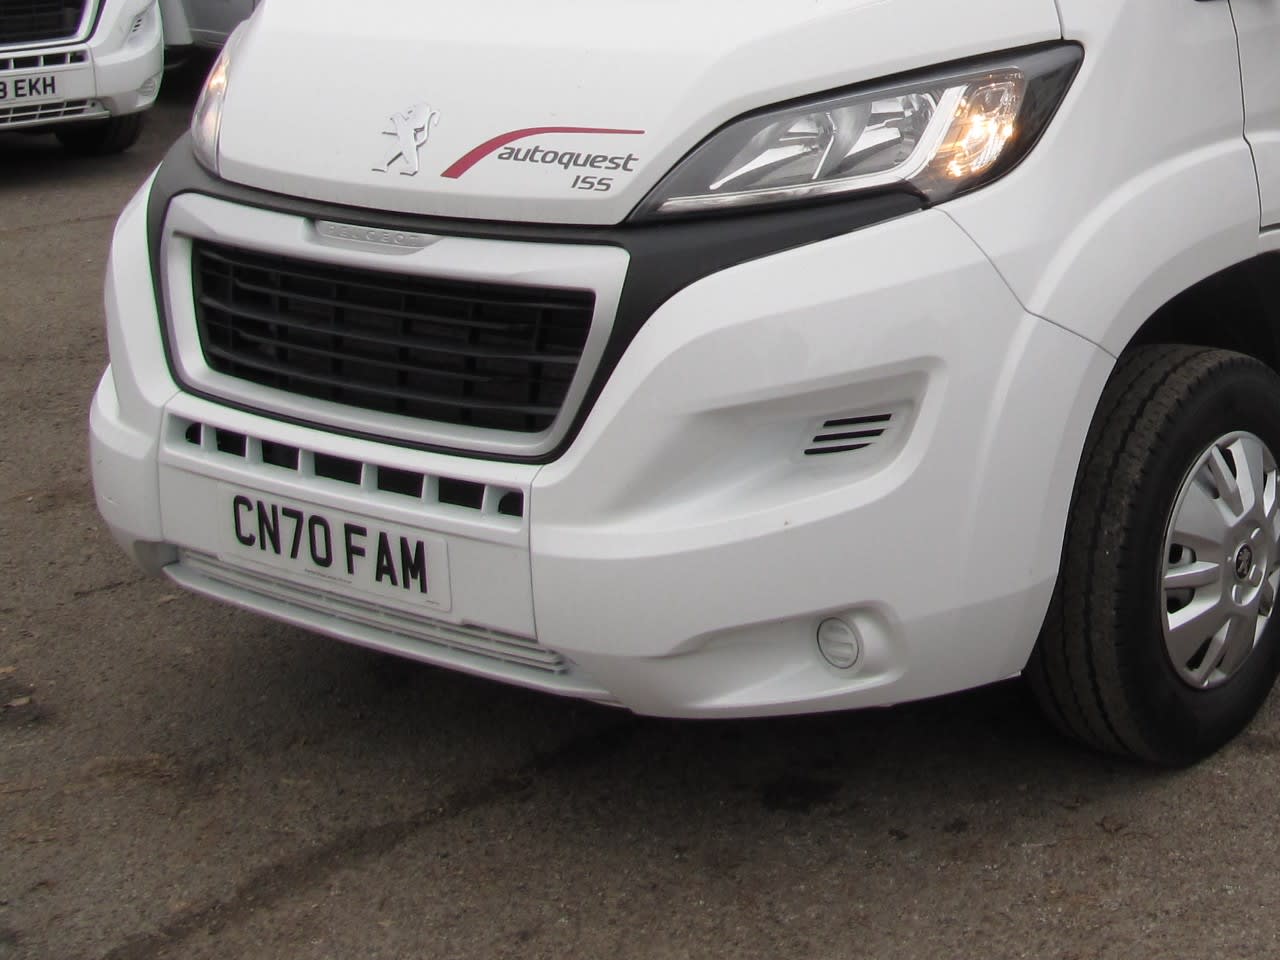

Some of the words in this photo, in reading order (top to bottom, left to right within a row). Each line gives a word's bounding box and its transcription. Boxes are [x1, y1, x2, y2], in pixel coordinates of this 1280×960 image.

[14, 75, 56, 98] EKH
[497, 145, 639, 172] autoquest
[571, 175, 613, 192] 155
[232, 494, 333, 568] CN70
[343, 522, 428, 594] FAM
